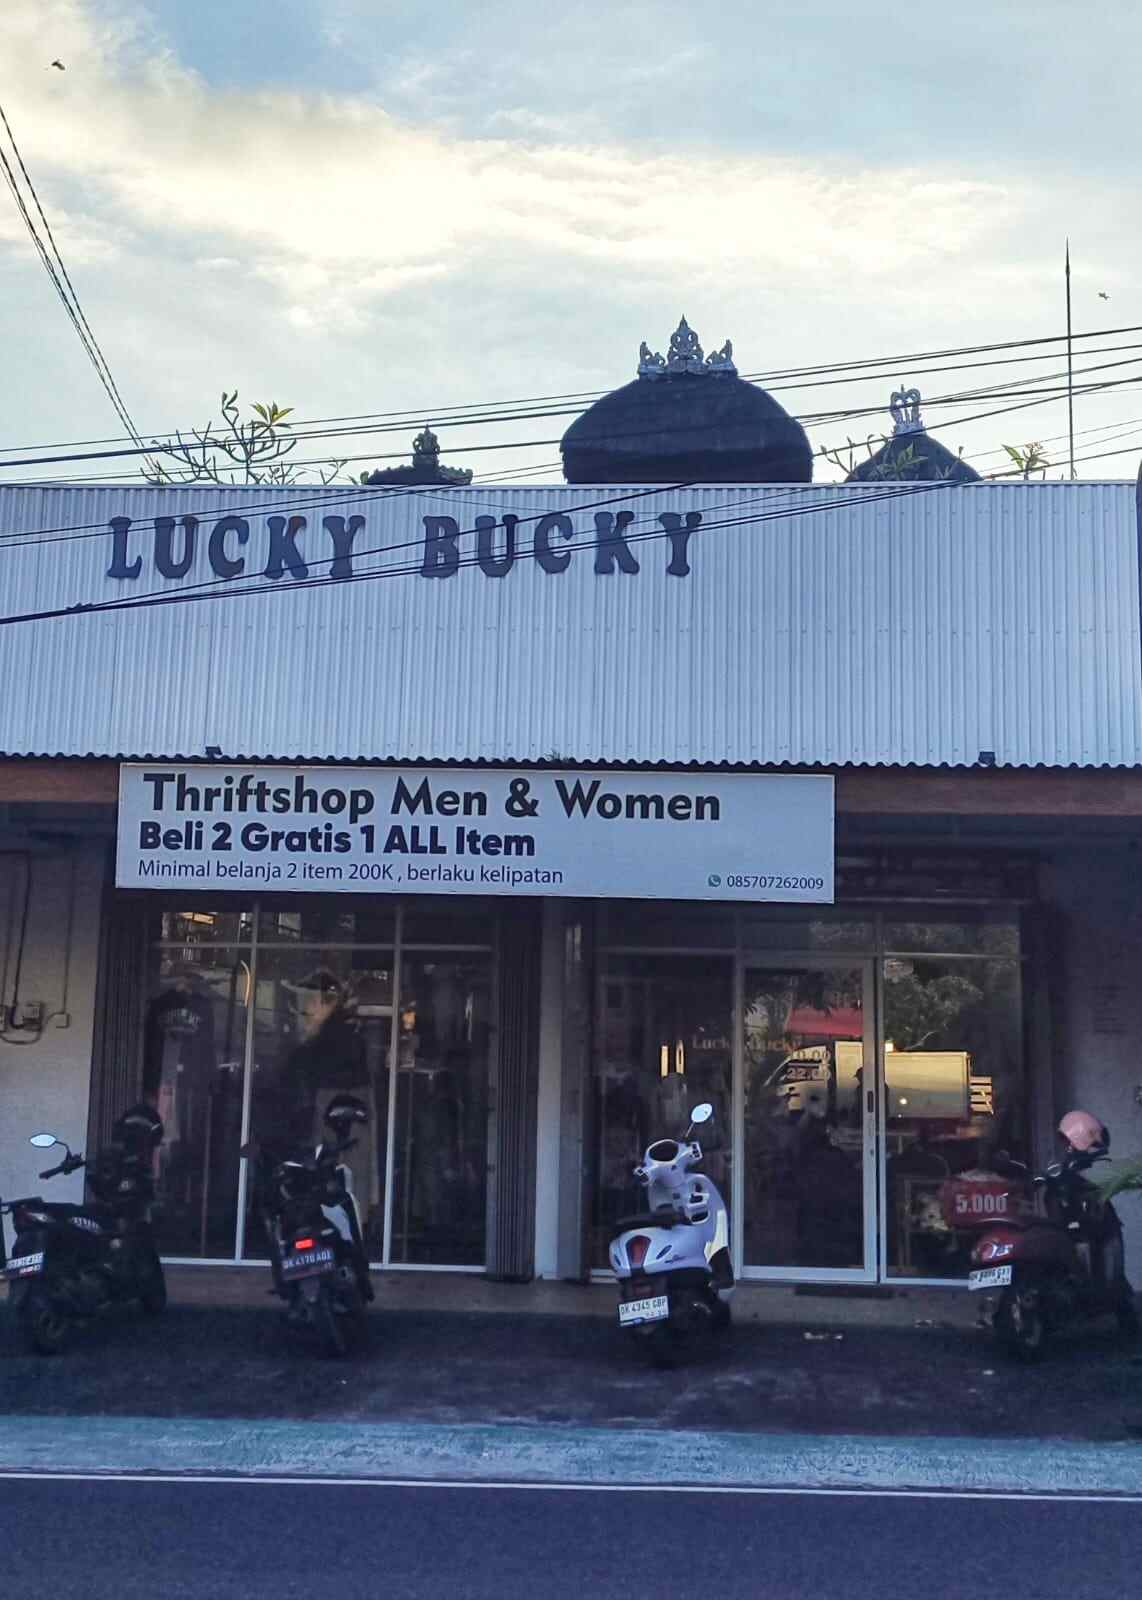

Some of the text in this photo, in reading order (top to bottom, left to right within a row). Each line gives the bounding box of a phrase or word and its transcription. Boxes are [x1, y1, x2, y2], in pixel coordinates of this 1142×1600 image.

[107, 510, 703, 580] LUCKY BUCKY
[142, 771, 720, 825] Thriftshop Men & Women
[139, 819, 536, 857] Beli 2 Gratis 1 ALL Item
[138, 858, 211, 877] Minimal
[216, 860, 281, 883] belanja
[287, 862, 297, 879] 2
[302, 862, 343, 880] item
[407, 863, 475, 883] berlaku
[480, 864, 563, 888] kelipatan
[726, 875, 824, 890] 085707262009
[955, 1193, 1008, 1214] 5.000
